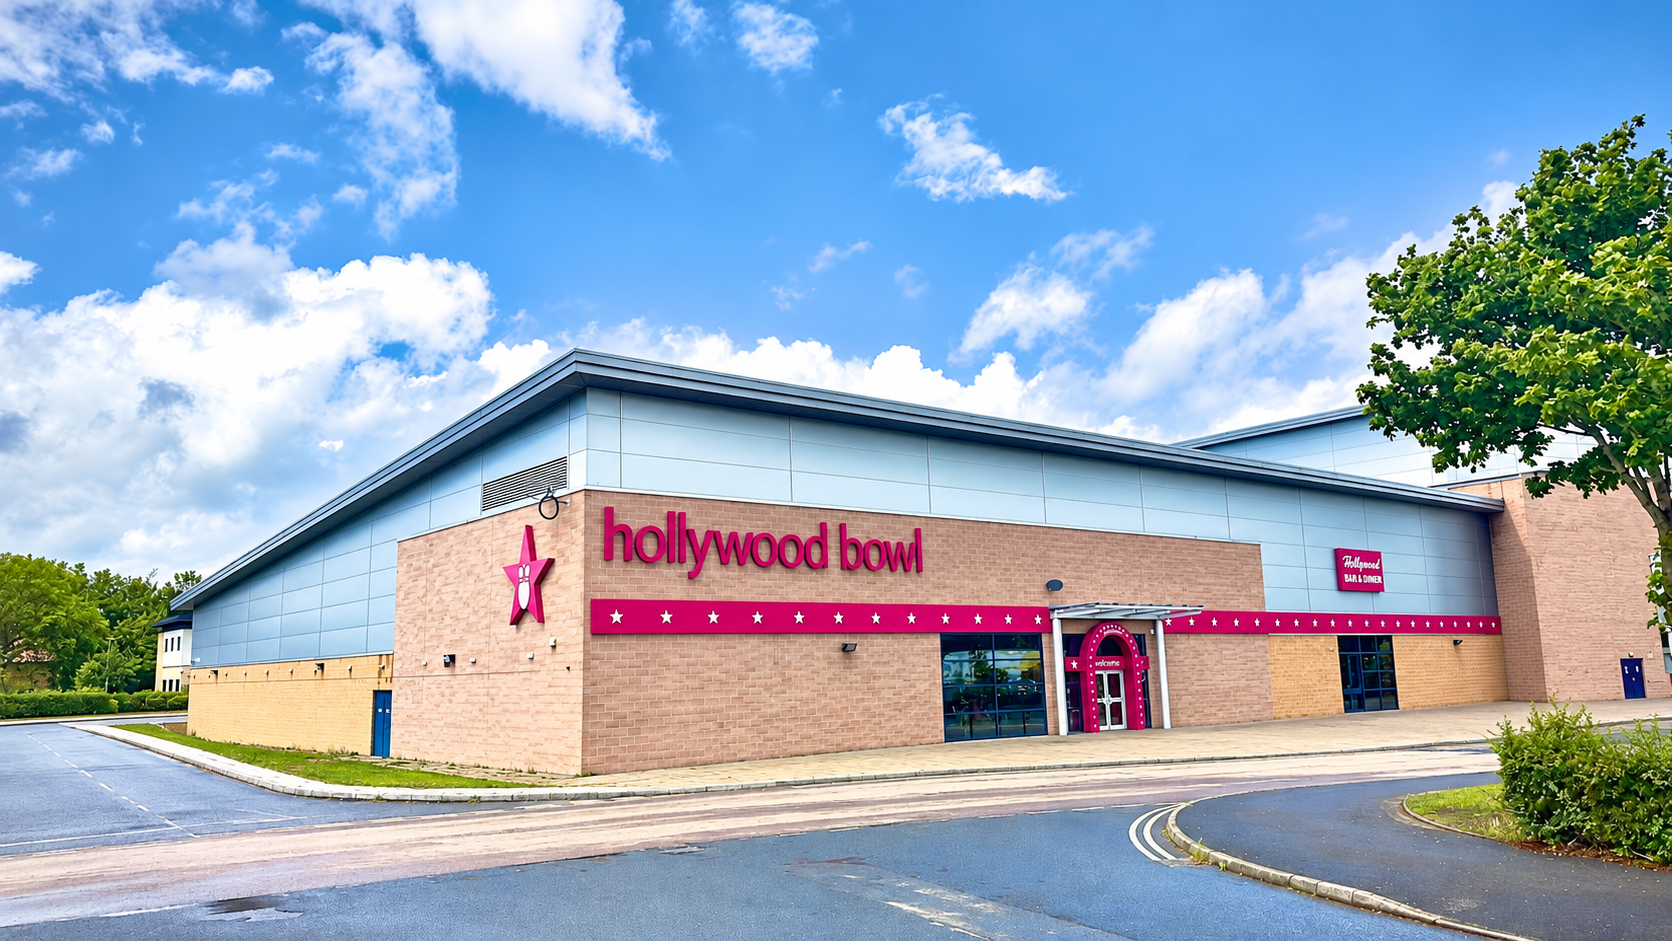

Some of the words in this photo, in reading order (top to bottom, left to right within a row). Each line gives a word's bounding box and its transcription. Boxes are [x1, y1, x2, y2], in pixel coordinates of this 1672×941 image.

[604, 506, 828, 579] hollywood
[839, 523, 923, 573] bowl
[1342, 555, 1380, 572] Hollywood
[1344, 574, 1357, 582] BAR
